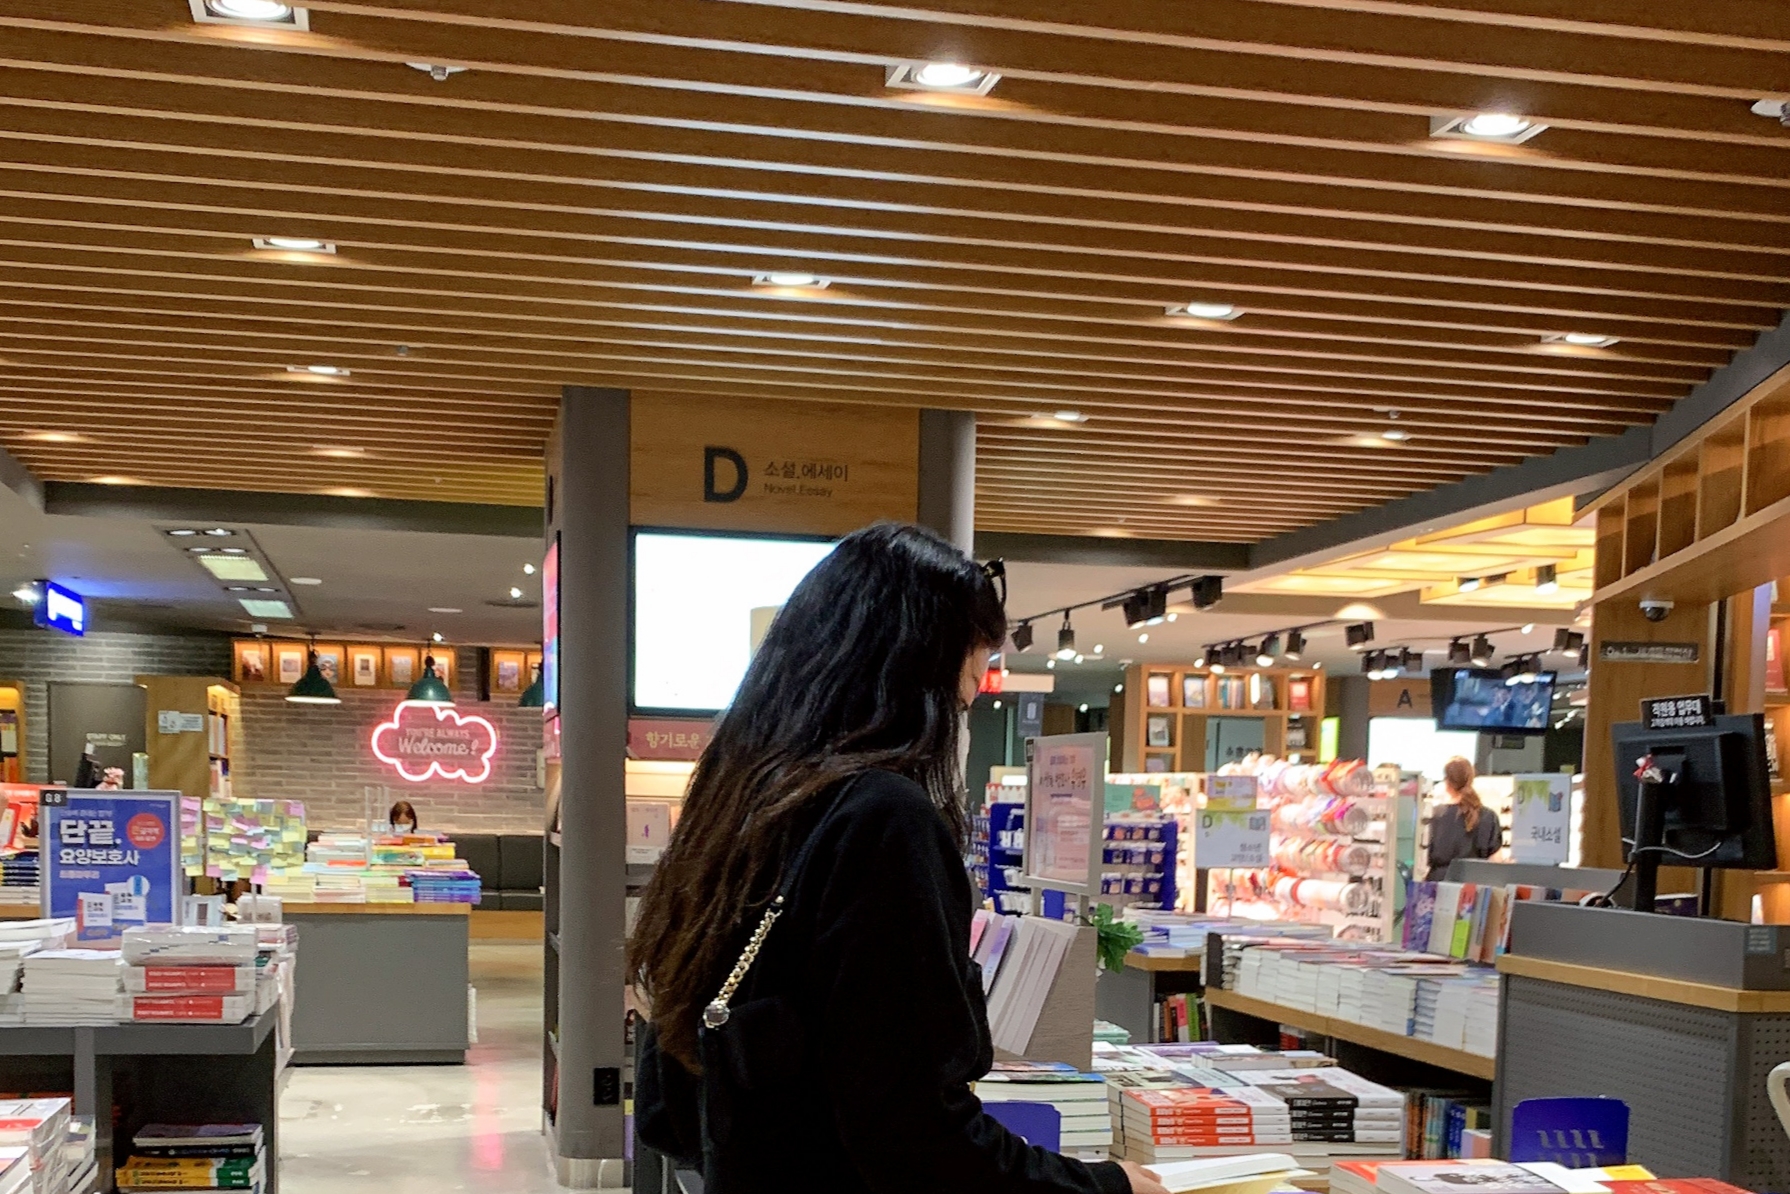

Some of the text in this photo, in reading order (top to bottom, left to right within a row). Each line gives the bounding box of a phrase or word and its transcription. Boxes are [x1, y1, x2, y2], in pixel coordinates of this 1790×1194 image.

[704, 446, 748, 503] D
[1396, 689, 1413, 710] A
[436, 728, 470, 738] ALWAYS
[645, 731, 700, 749] 향기로운
[1202, 815, 1213, 828] D
[1531, 826, 1562, 844] 국내소설
[59, 848, 140, 866] 요양보호사
